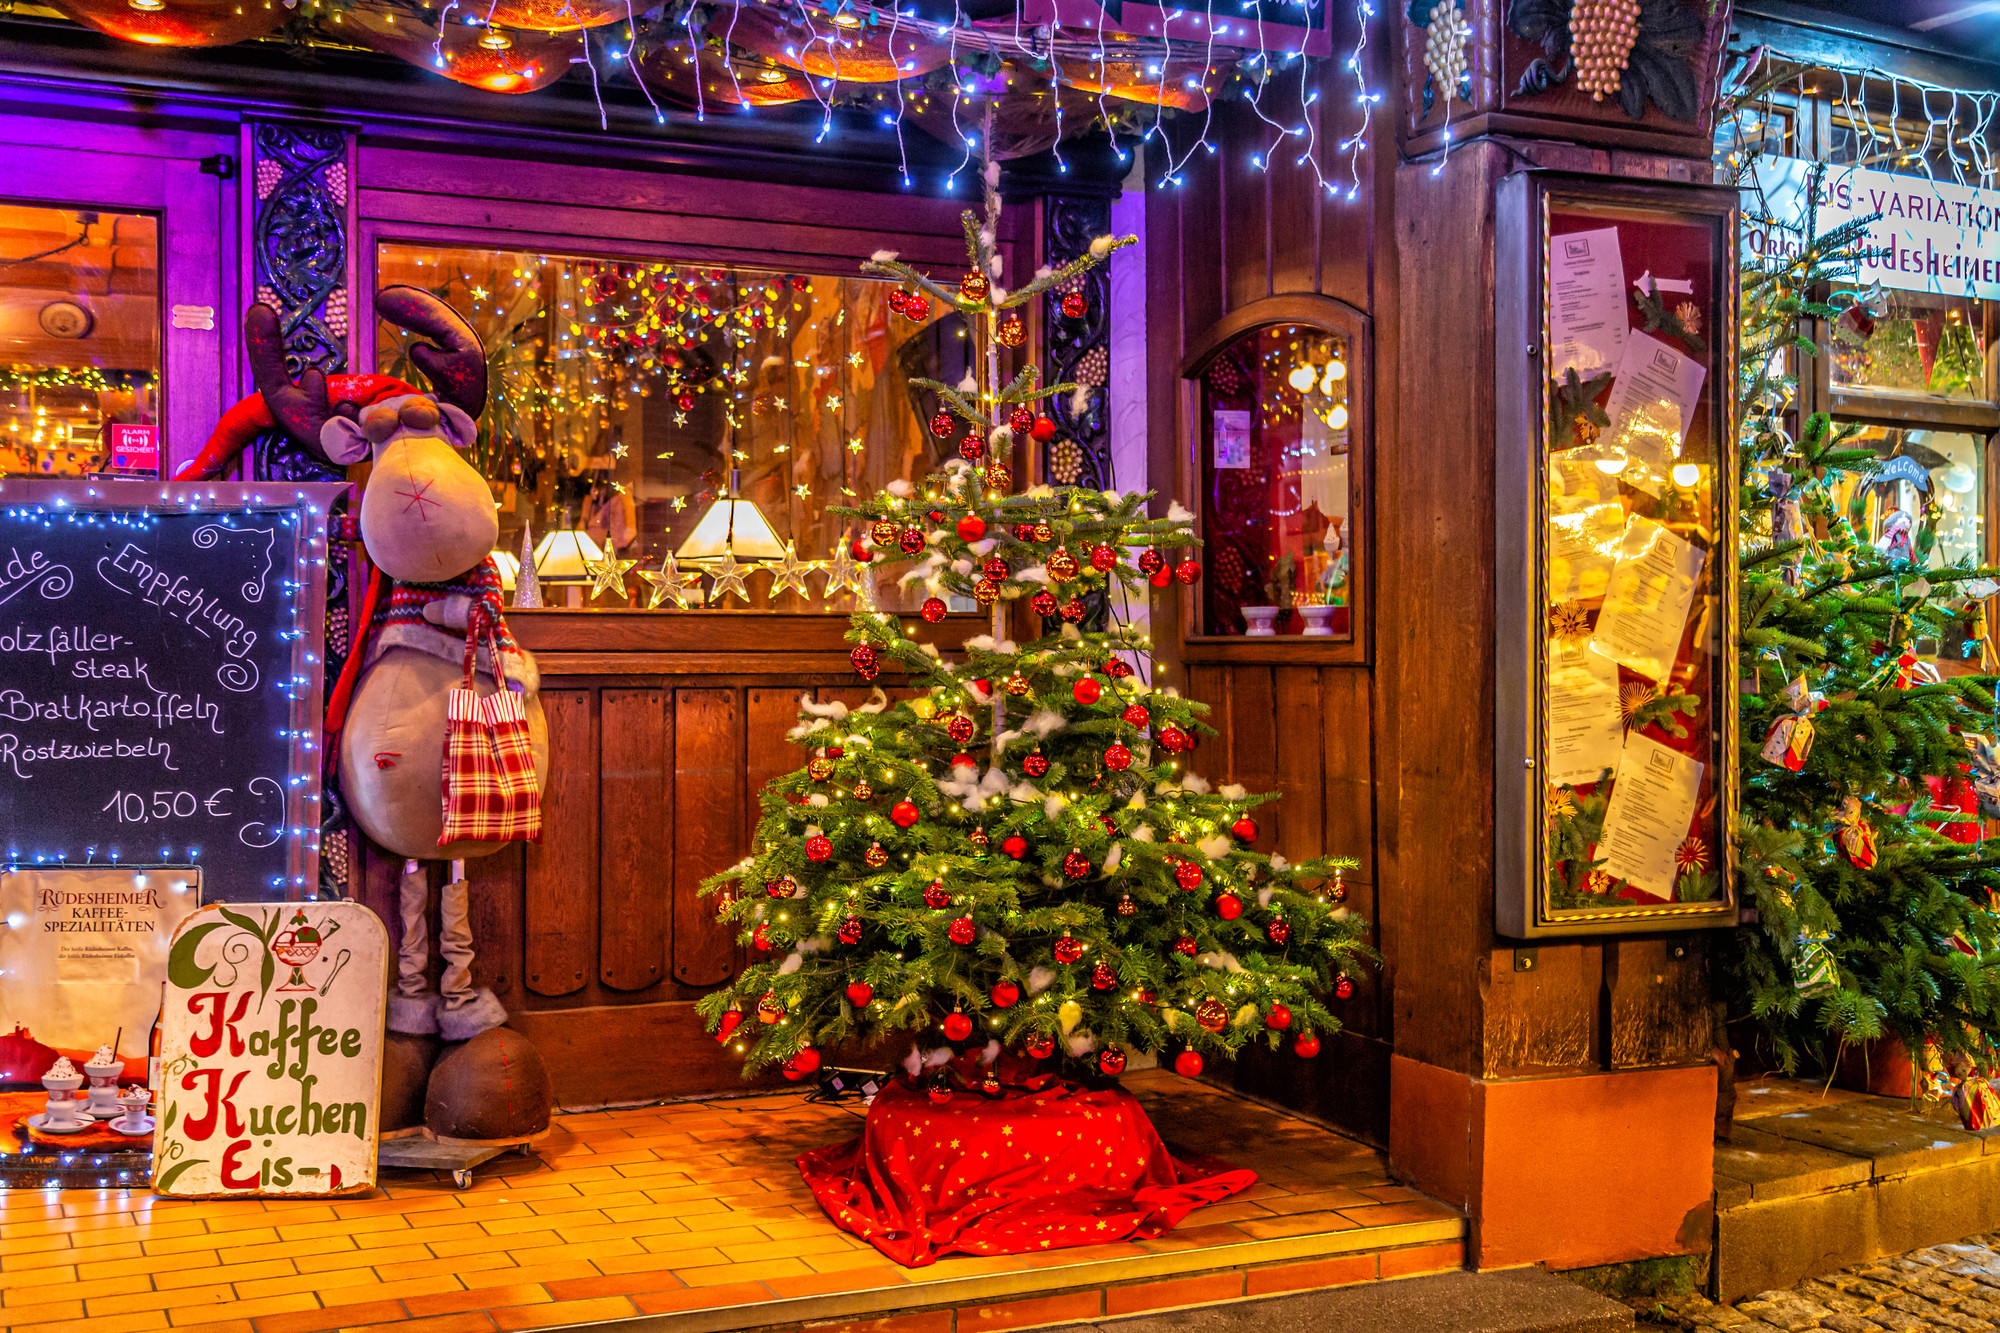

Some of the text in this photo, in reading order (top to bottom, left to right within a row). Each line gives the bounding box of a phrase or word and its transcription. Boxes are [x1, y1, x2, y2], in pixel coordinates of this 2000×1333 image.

[116, 445, 155, 453] GESICHERT
[113, 543, 257, 657] Empfehlung
[72, 657, 168, 694] steak
[0, 689, 224, 734] Bratkartoffeln
[0, 733, 179, 778] Röstzwiebeln
[102, 788, 234, 823] 10,50 €
[44, 919, 155, 932] SPEZIALITÄTEN
[72, 907, 128, 918] KAFFEE-
[187, 991, 362, 1080] Kaffee
[181, 1068, 367, 1141] Kuchen
